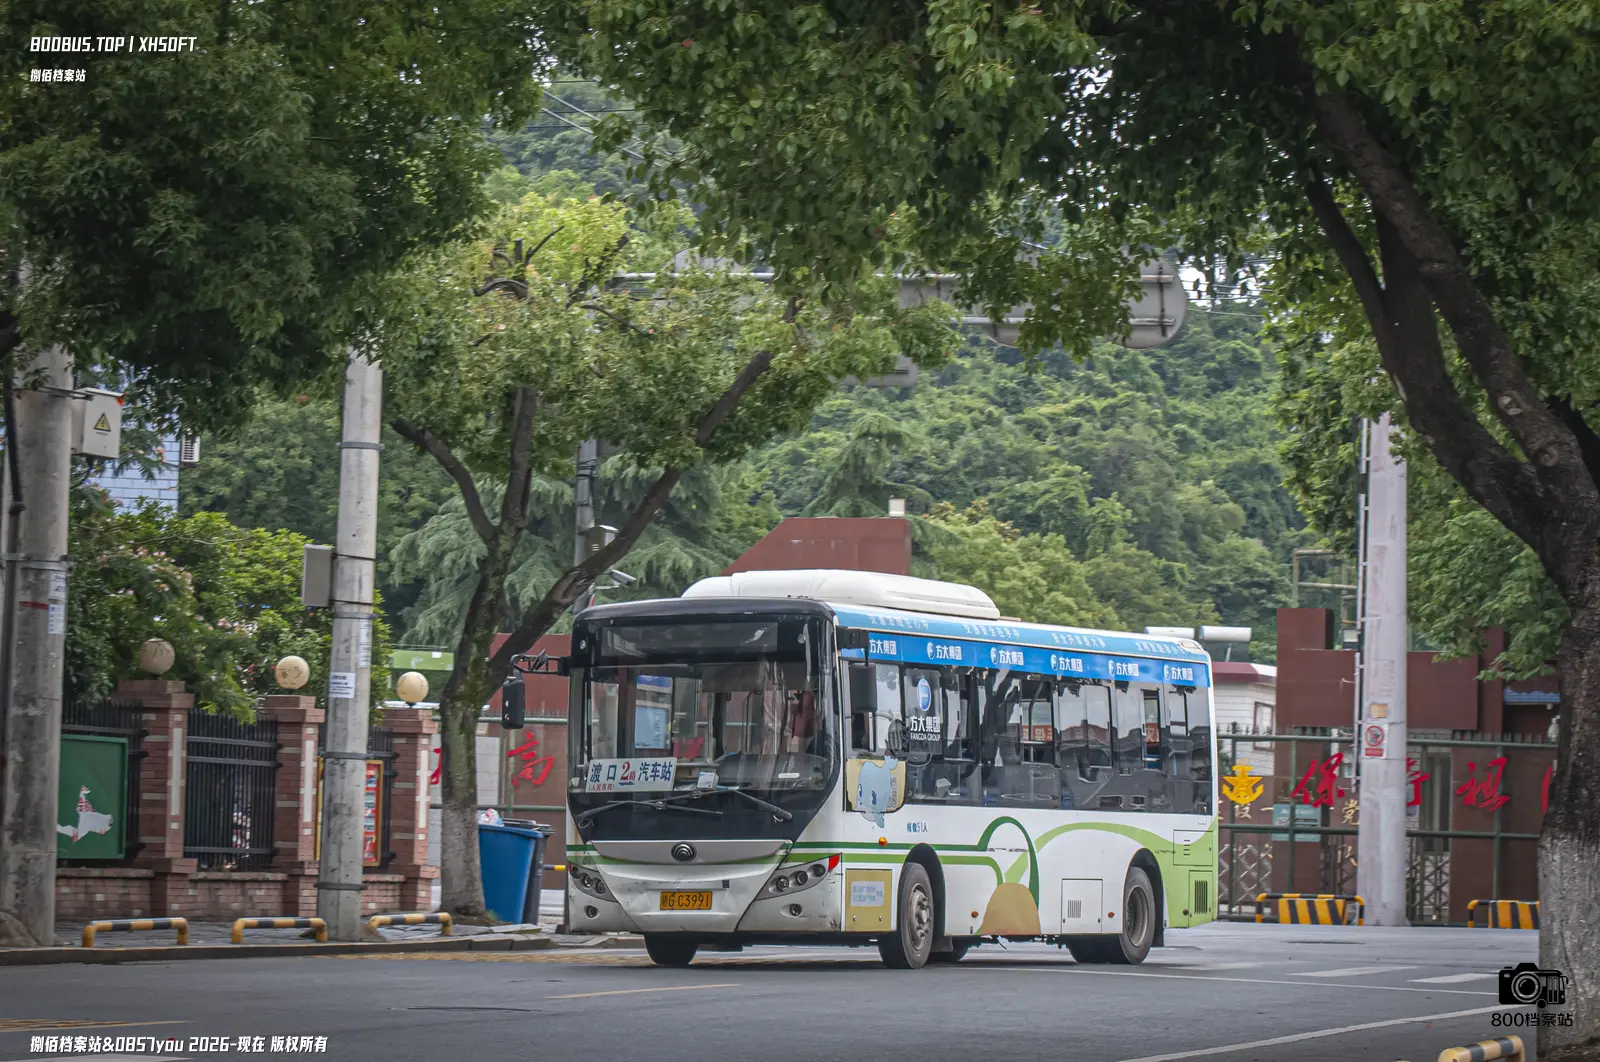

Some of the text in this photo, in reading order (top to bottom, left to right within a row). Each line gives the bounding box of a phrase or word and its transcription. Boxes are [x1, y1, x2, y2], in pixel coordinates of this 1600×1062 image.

[869, 639, 897, 655] 方大集团
[936, 644, 962, 660] 方大集团
[999, 649, 1024, 666] 方大集团
[1059, 656, 1083, 672] 方大集团
[1116, 661, 1139, 677] 方大集团
[1171, 666, 1193, 681] 方大集团
[910, 715, 940, 733] 方大集团
[928, 733, 940, 742] GROUP
[638, 761, 673, 782] 汽车站
